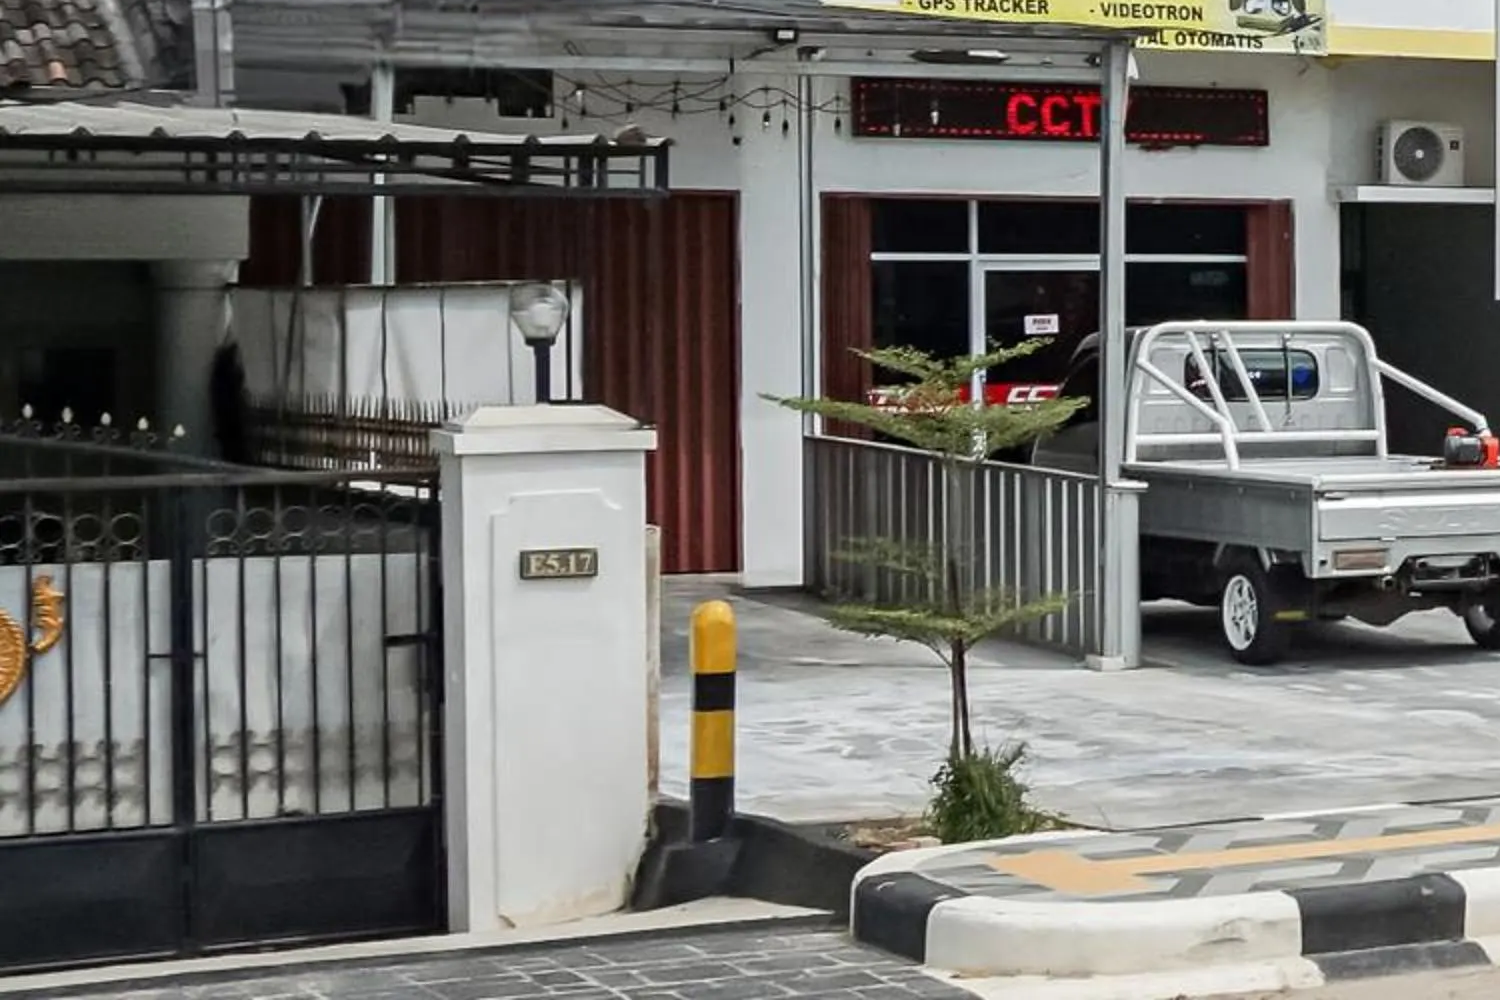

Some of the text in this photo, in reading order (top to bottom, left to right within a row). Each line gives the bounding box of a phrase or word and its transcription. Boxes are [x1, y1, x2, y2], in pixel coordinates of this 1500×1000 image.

[1100, 1, 1204, 22] VIDEOTRON
[1174, 30, 1264, 49] OTOMATIS
[1006, 93, 1104, 137] CCT
